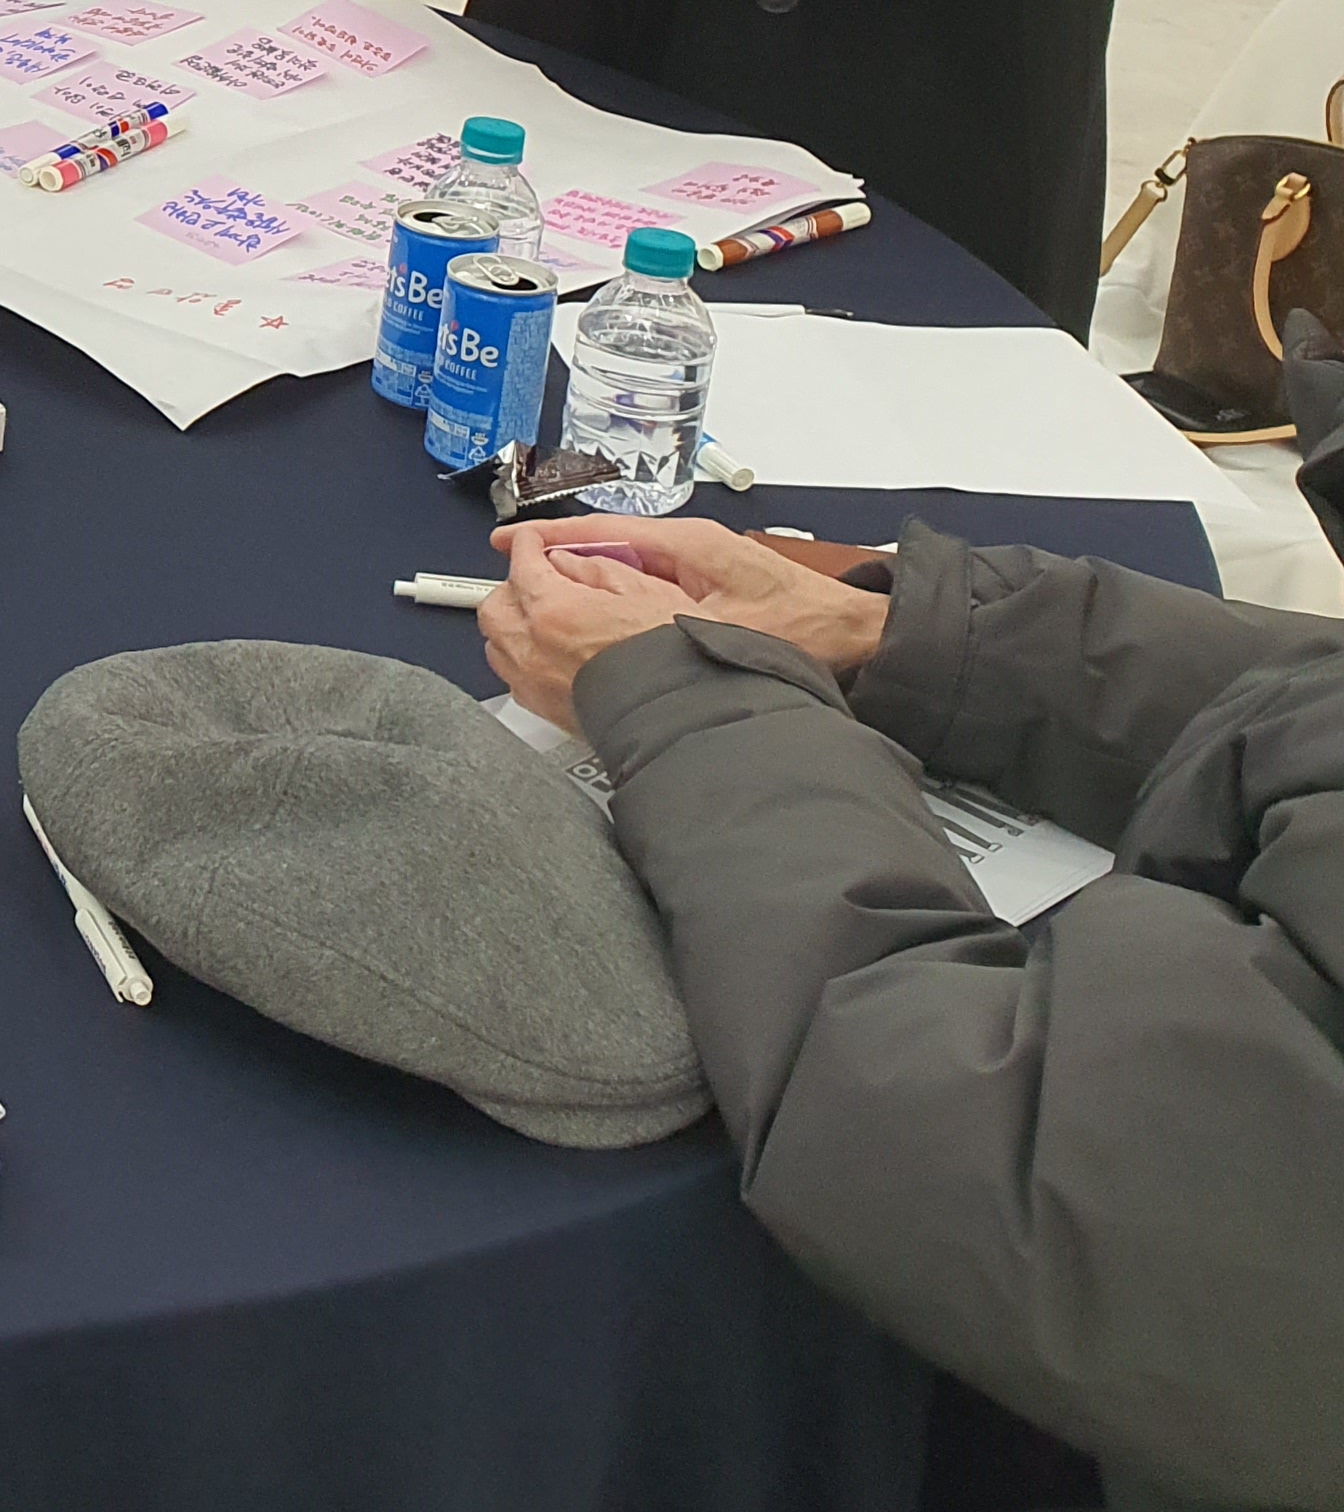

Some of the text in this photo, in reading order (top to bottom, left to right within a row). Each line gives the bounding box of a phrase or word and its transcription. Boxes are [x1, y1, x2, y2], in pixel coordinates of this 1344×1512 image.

[408, 270, 443, 309] Be
[393, 298, 424, 321] COFFEE
[460, 327, 499, 368] Be
[445, 358, 477, 381] COFFEE
